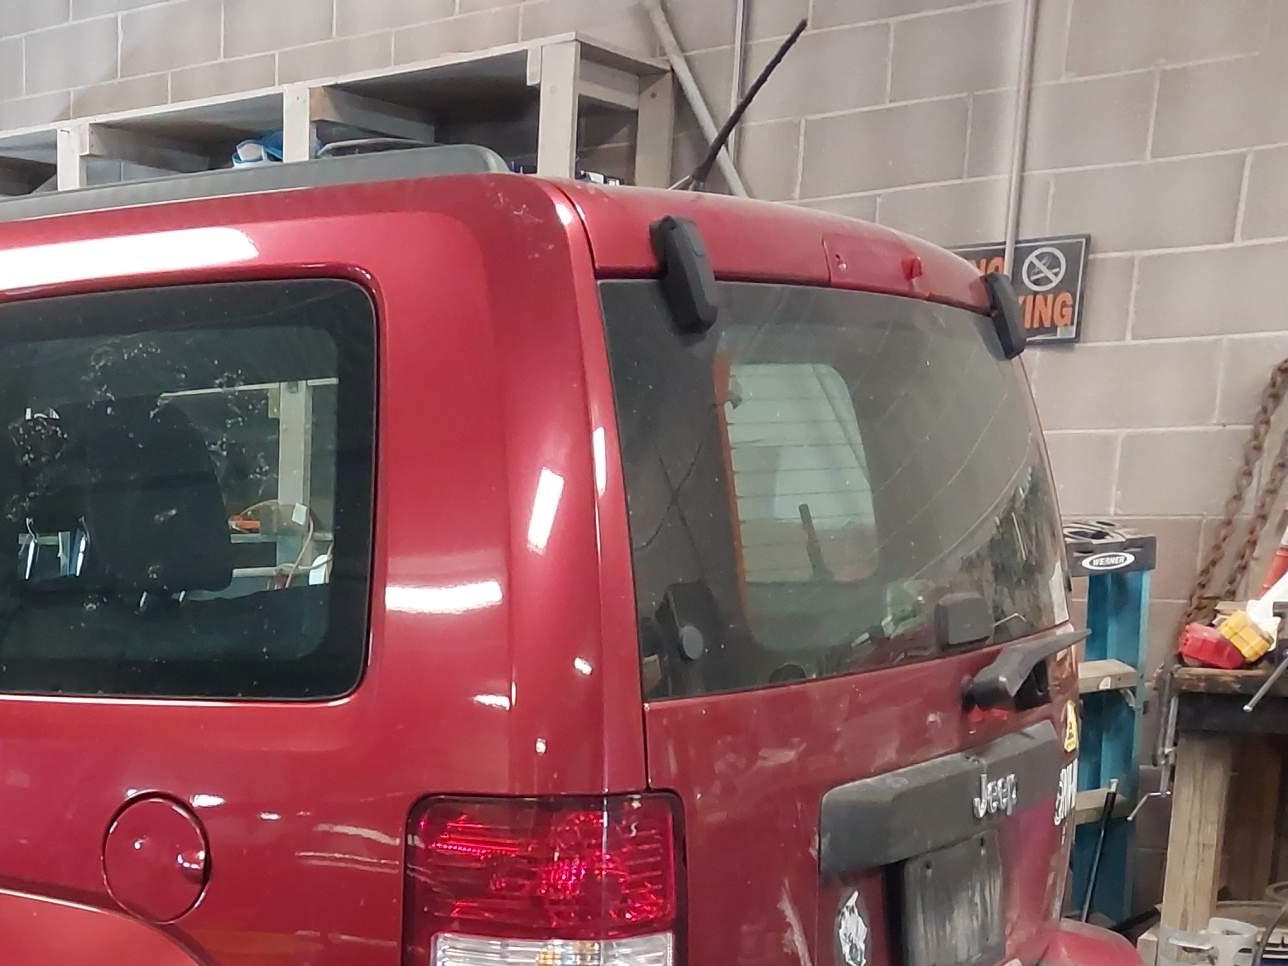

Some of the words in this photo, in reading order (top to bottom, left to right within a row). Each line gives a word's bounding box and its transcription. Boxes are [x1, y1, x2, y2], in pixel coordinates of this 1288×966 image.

[1018, 292, 1073, 329] ING
[1092, 555, 1126, 567] WERNER
[973, 773, 1017, 818] Jeep
